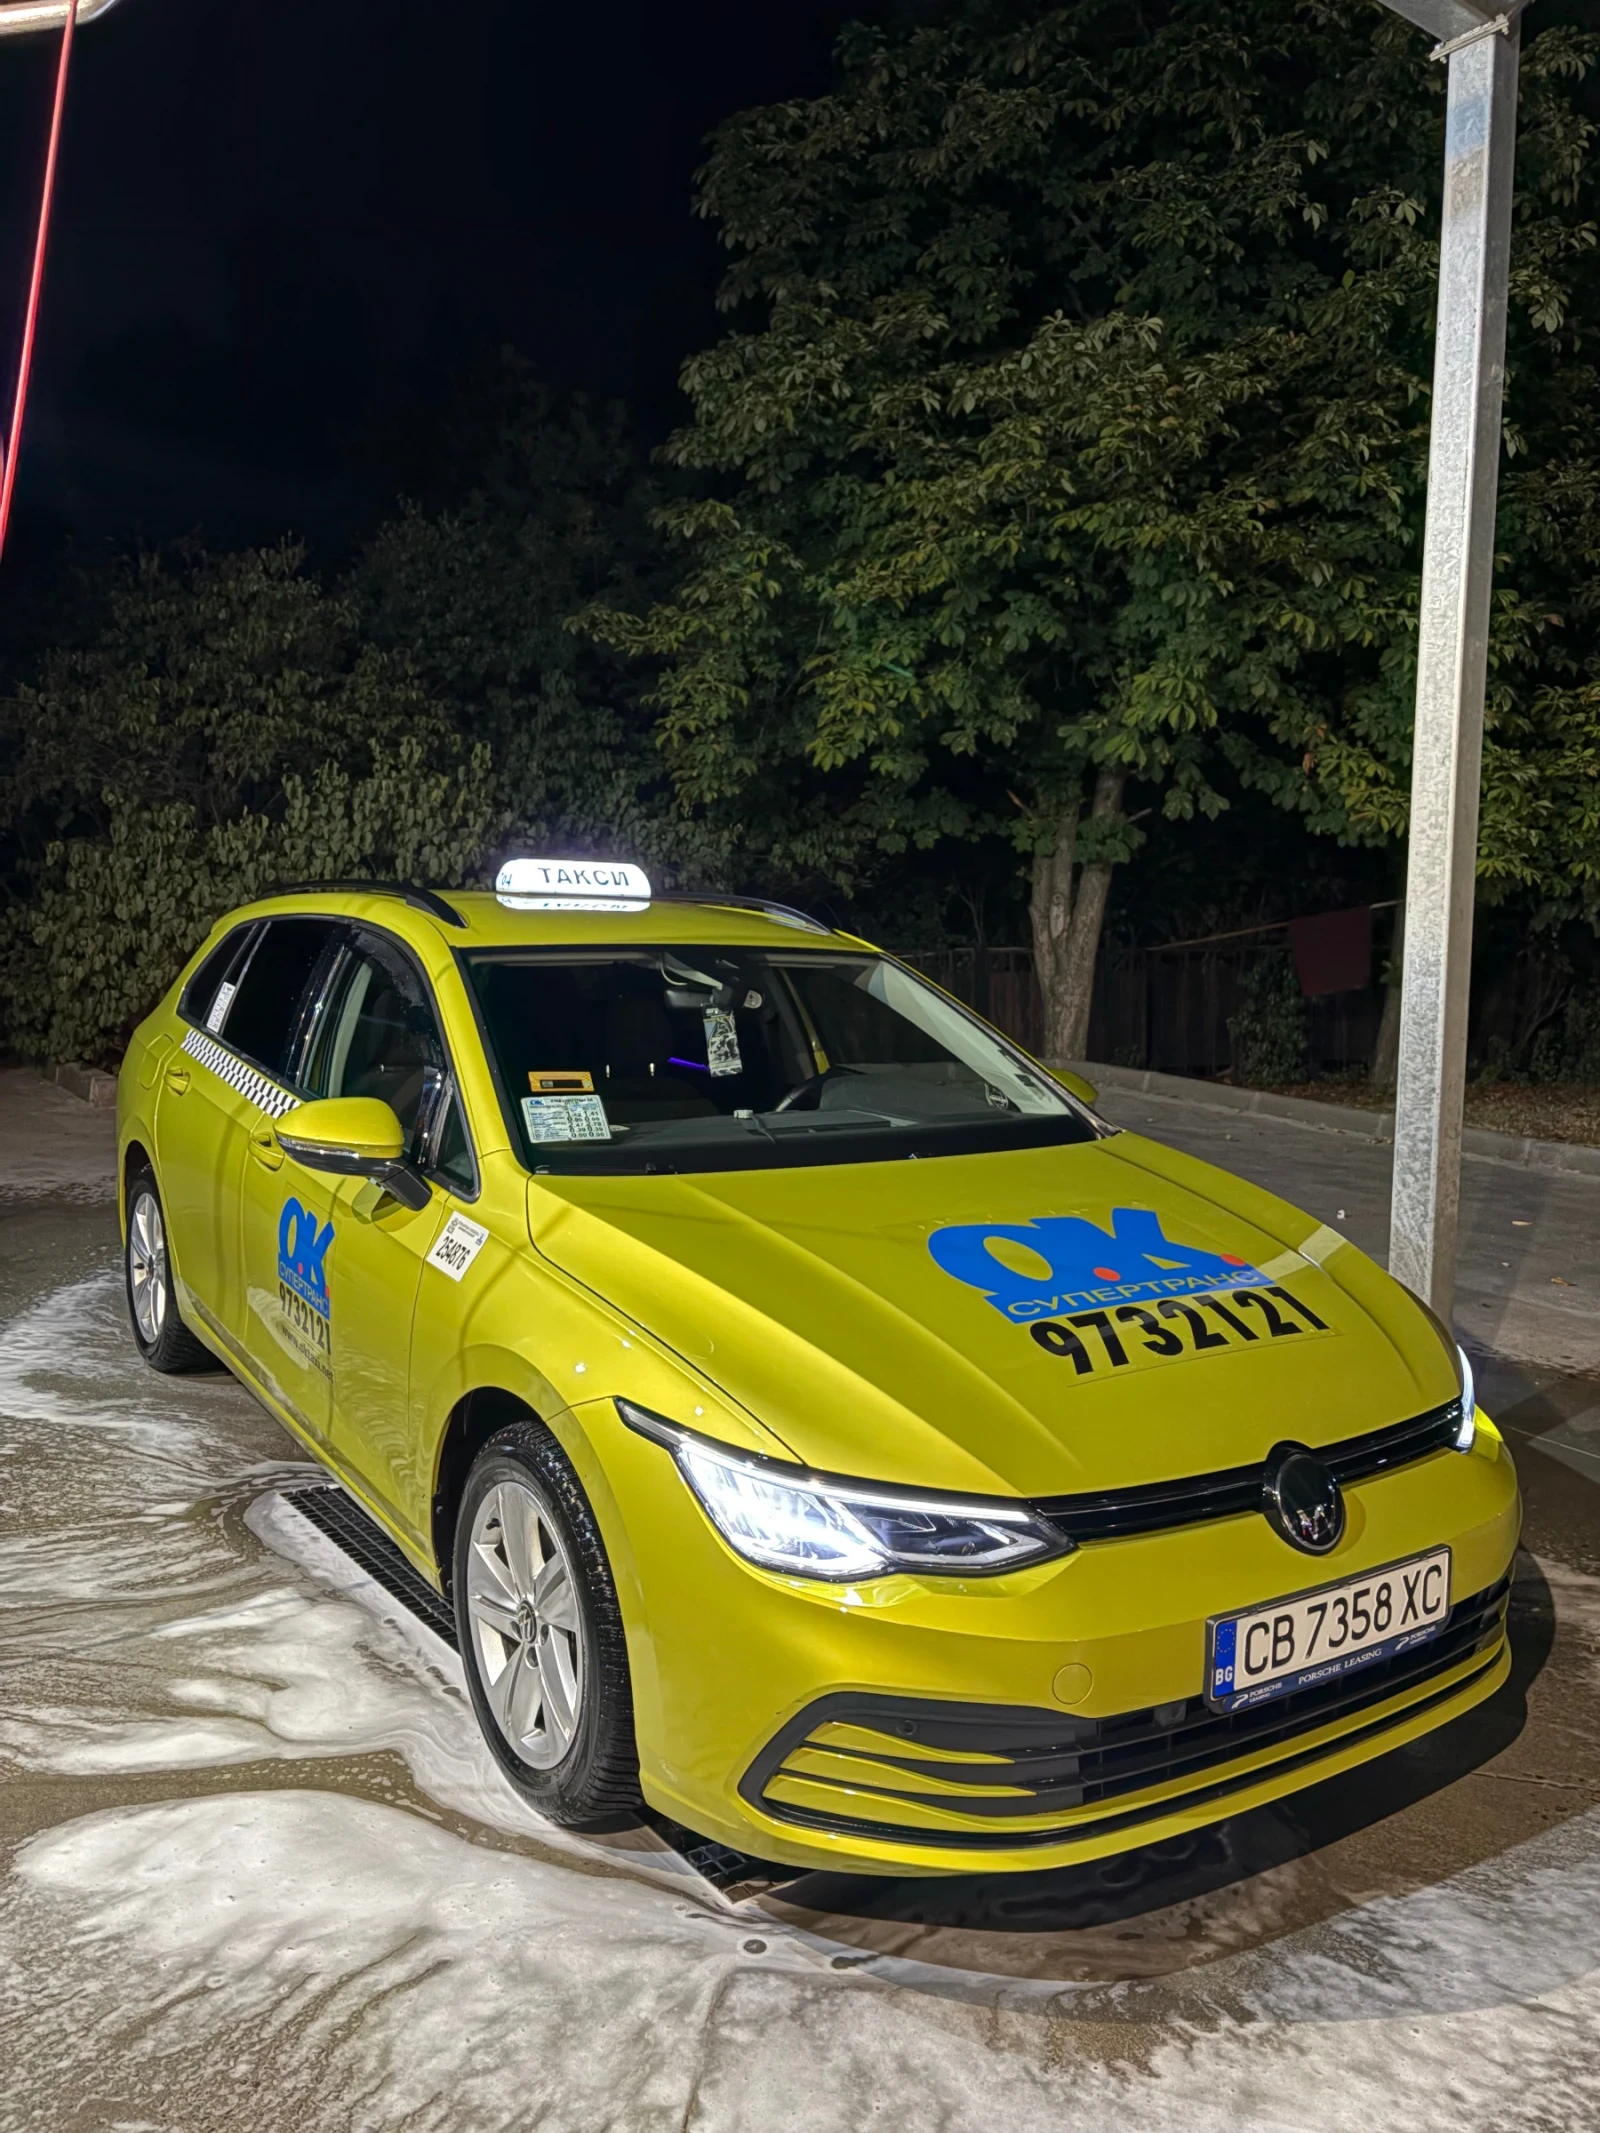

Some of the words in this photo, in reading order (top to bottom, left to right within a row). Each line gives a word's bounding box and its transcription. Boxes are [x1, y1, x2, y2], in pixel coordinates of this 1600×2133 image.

[538, 867, 629, 886] ТАКСИ
[435, 1236, 471, 1271] 254876
[279, 1261, 330, 1316] СУПЕРТРАНС
[1007, 1269, 1260, 1317] СУПЕРТРАНС
[279, 1281, 331, 1356] 9732121
[1029, 1286, 1330, 1376] 9732121
[1305, 1582, 1392, 1660] 7358
[1215, 1665, 1234, 1686] BG
[1298, 1664, 1341, 1685] PORSCHE
[1344, 1648, 1382, 1669] LEASING
